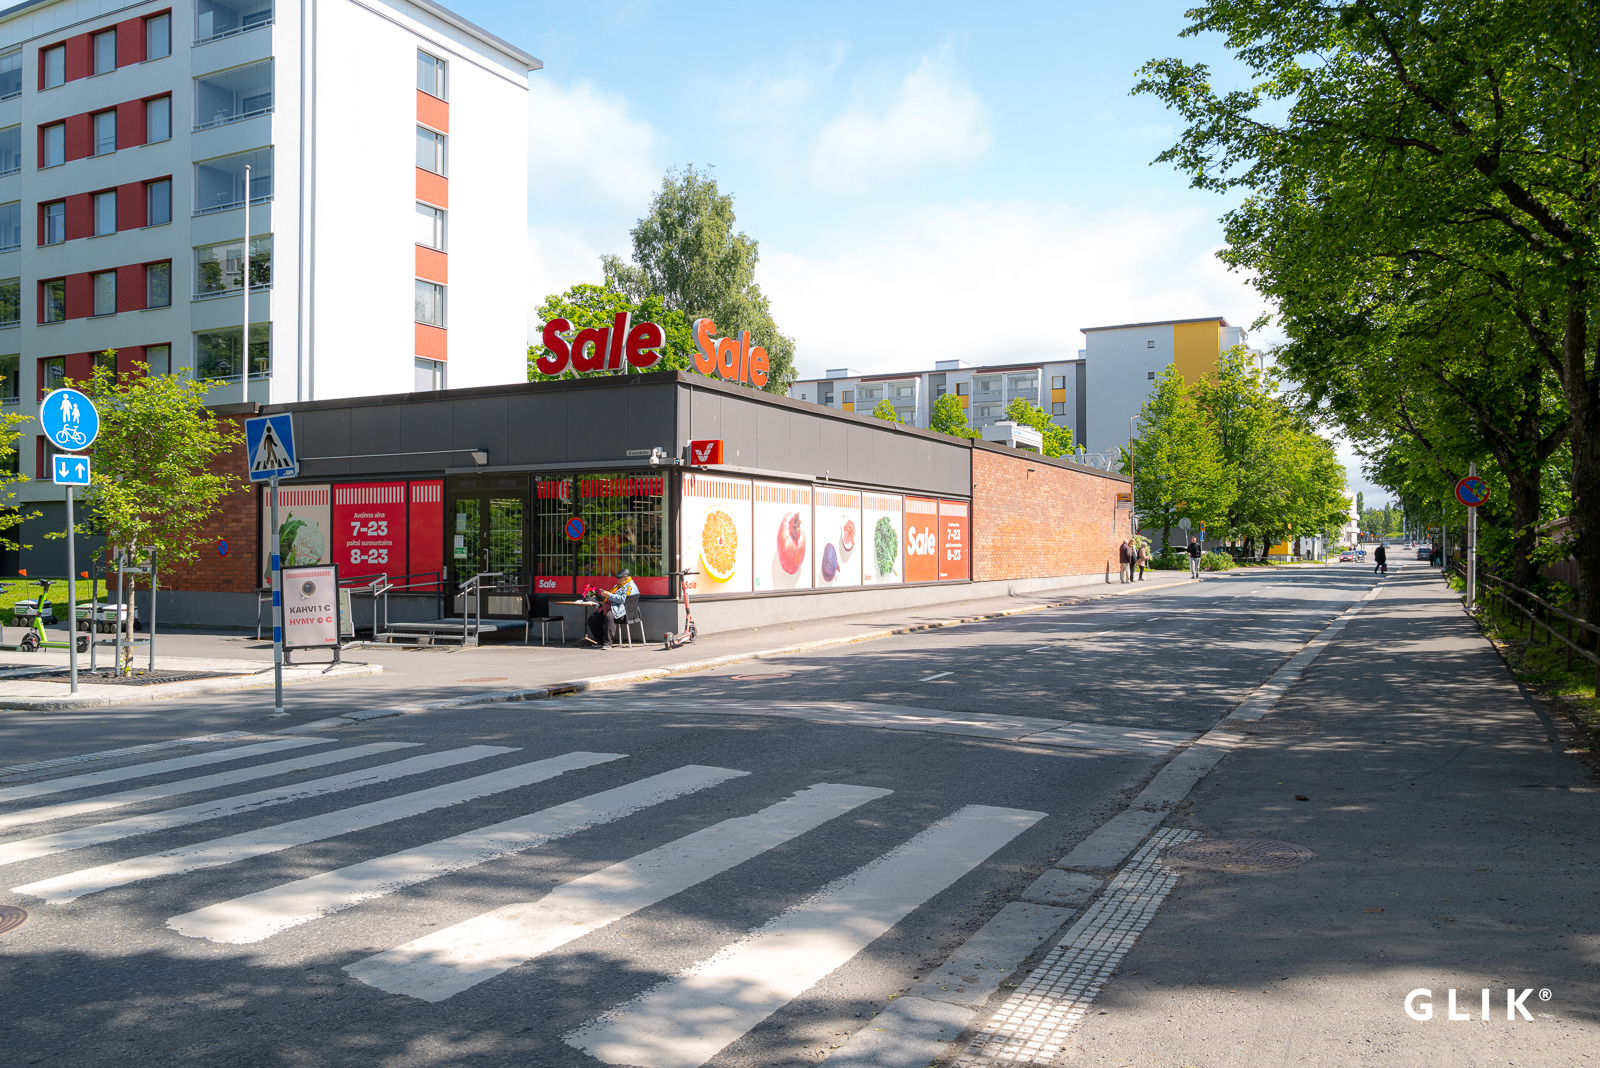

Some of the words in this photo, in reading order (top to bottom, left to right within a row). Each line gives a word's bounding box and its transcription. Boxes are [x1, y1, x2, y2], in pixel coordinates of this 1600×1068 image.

[536, 311, 665, 376] Sale
[689, 318, 769, 387] Sale
[350, 520, 388, 536] 7-23
[907, 526, 936, 556] Sale
[946, 529, 961, 541] 7-23
[346, 539, 361, 547] paitsi
[350, 548, 388, 564] 8-23
[946, 549, 961, 561] 8-23
[538, 579, 557, 589] Sale
[685, 581, 697, 589] Sale
[289, 605, 316, 613] KAHVI
[289, 617, 315, 626] HYMY
